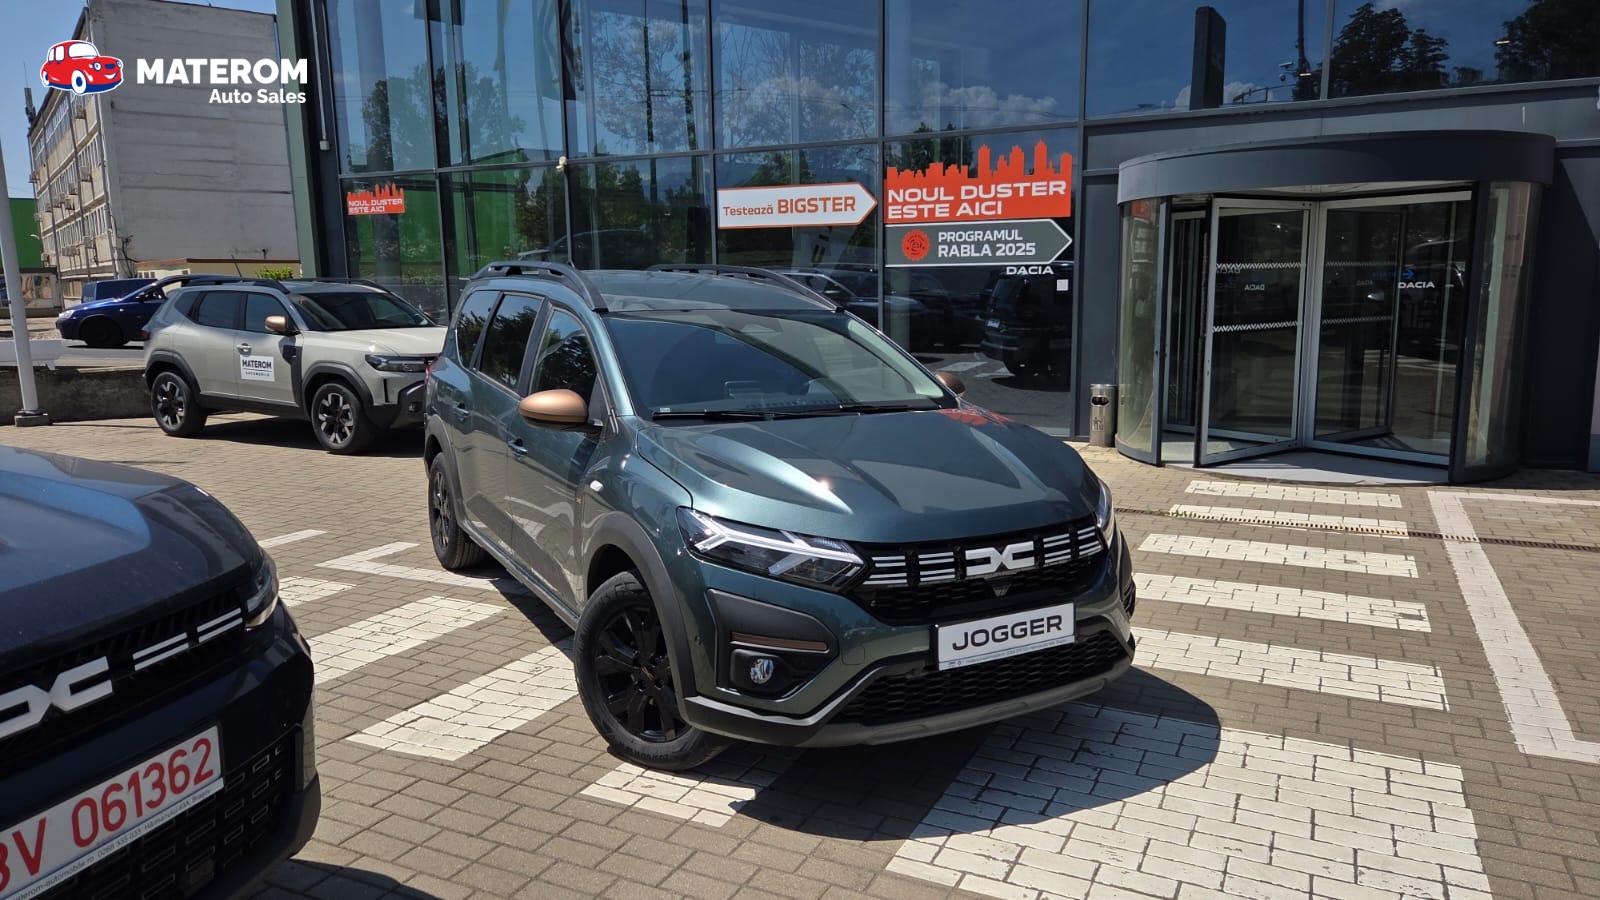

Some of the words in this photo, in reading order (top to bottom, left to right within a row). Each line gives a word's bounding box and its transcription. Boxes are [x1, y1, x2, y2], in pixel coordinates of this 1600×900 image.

[887, 187, 954, 203] NOUL
[960, 180, 1067, 200] DUSTER
[371, 198, 403, 206] DUSTER
[722, 204, 774, 217] Testează
[777, 196, 856, 214] BIGSTER
[887, 203, 950, 219] ESTE
[955, 201, 1002, 217] AICI
[938, 229, 1023, 242] PROGRAMUL
[938, 244, 992, 258] RABLA
[995, 242, 1036, 256] 2025
[1006, 266, 1054, 275] DACIA
[1397, 281, 1436, 289] DACIA
[242, 359, 272, 369] MATEROM
[952, 614, 1063, 651] JOGGER
[71, 737, 214, 848] 061362
